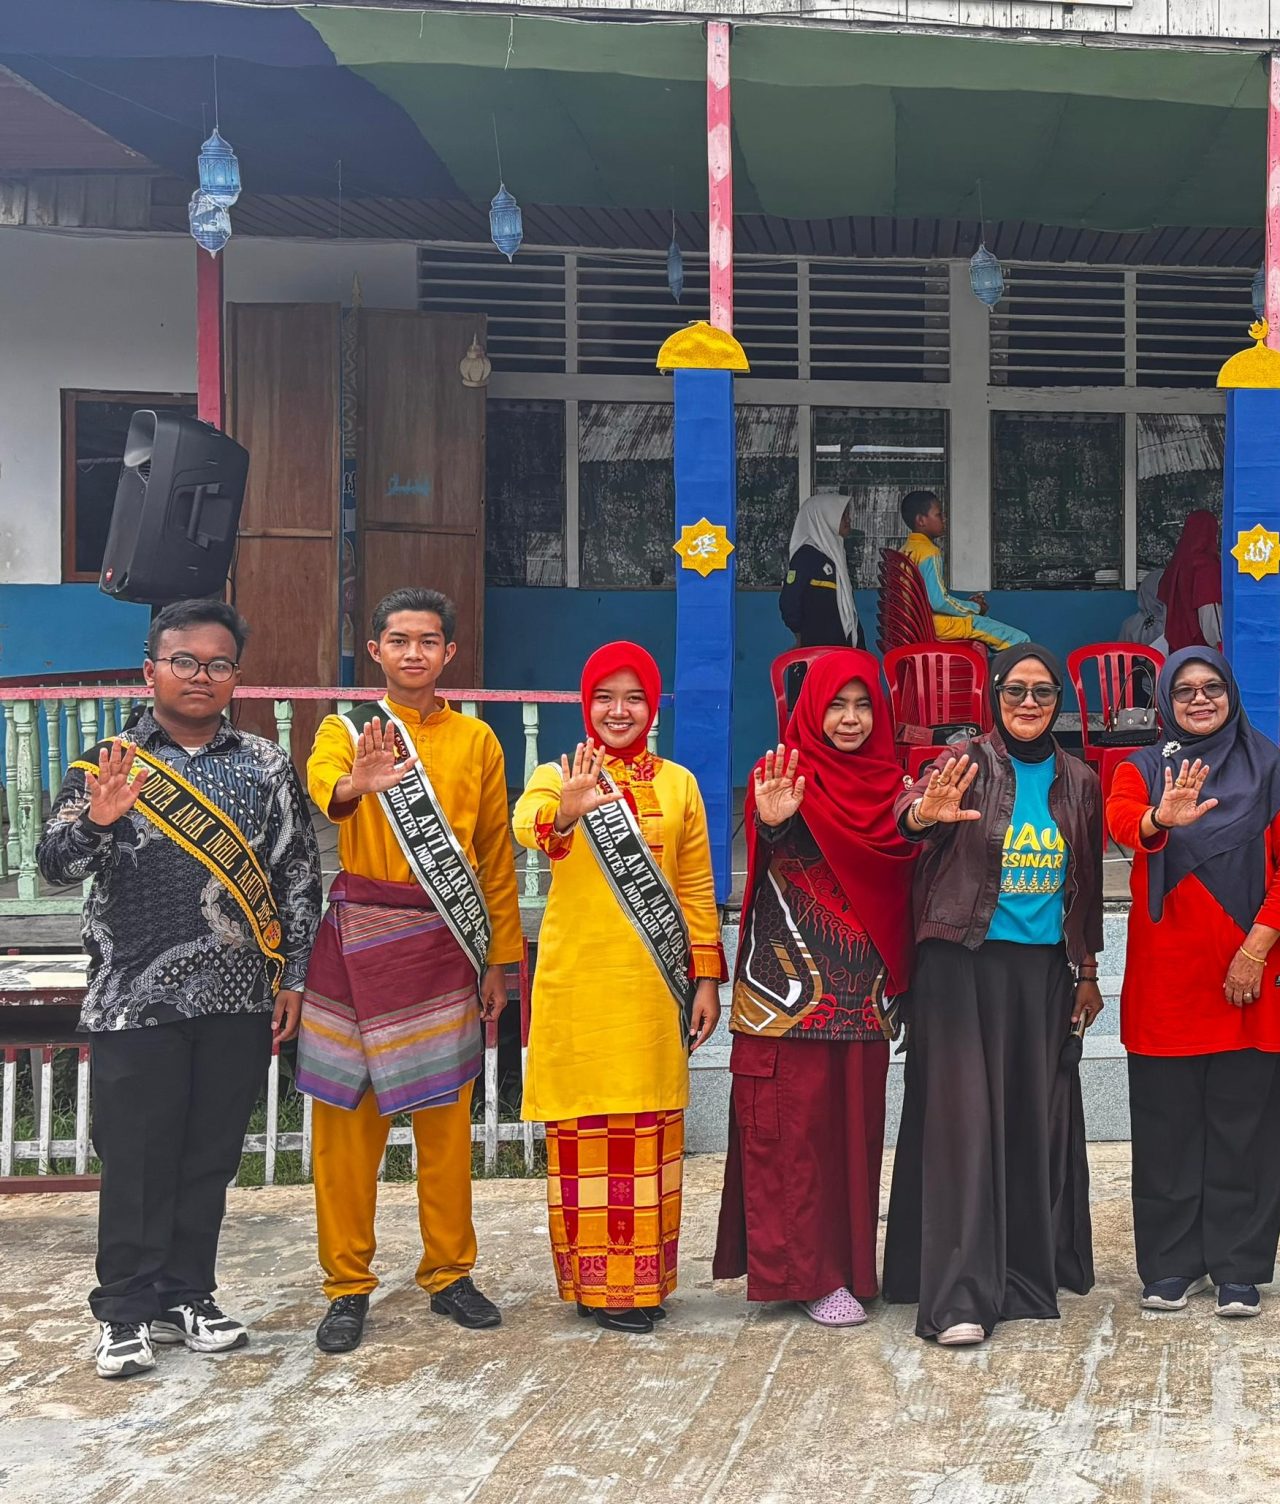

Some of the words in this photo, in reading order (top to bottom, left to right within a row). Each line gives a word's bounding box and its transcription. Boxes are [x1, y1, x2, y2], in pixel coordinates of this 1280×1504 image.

[140, 773, 177, 811] DUTA
[169, 801, 216, 841] ANAK
[203, 829, 243, 870] INHIL
[233, 860, 265, 905] TAHUN
[387, 785, 421, 839] BUPATEN
[413, 843, 455, 902] INDRAGIRI
[450, 904, 472, 937] HILIR
[400, 769, 425, 805] UTA
[415, 812, 450, 855] ANTI
[438, 854, 486, 931] NARKOBA
[586, 809, 627, 878] KABUPATEN
[621, 881, 663, 940] INDRAGIRI
[657, 937, 675, 971] HILIR
[598, 800, 631, 845] DUTA
[622, 850, 658, 893] ANTI
[647, 892, 686, 963] NARKOBA
[1002, 852, 1063, 869] RSINAR
[1003, 822, 1065, 853] IAU
